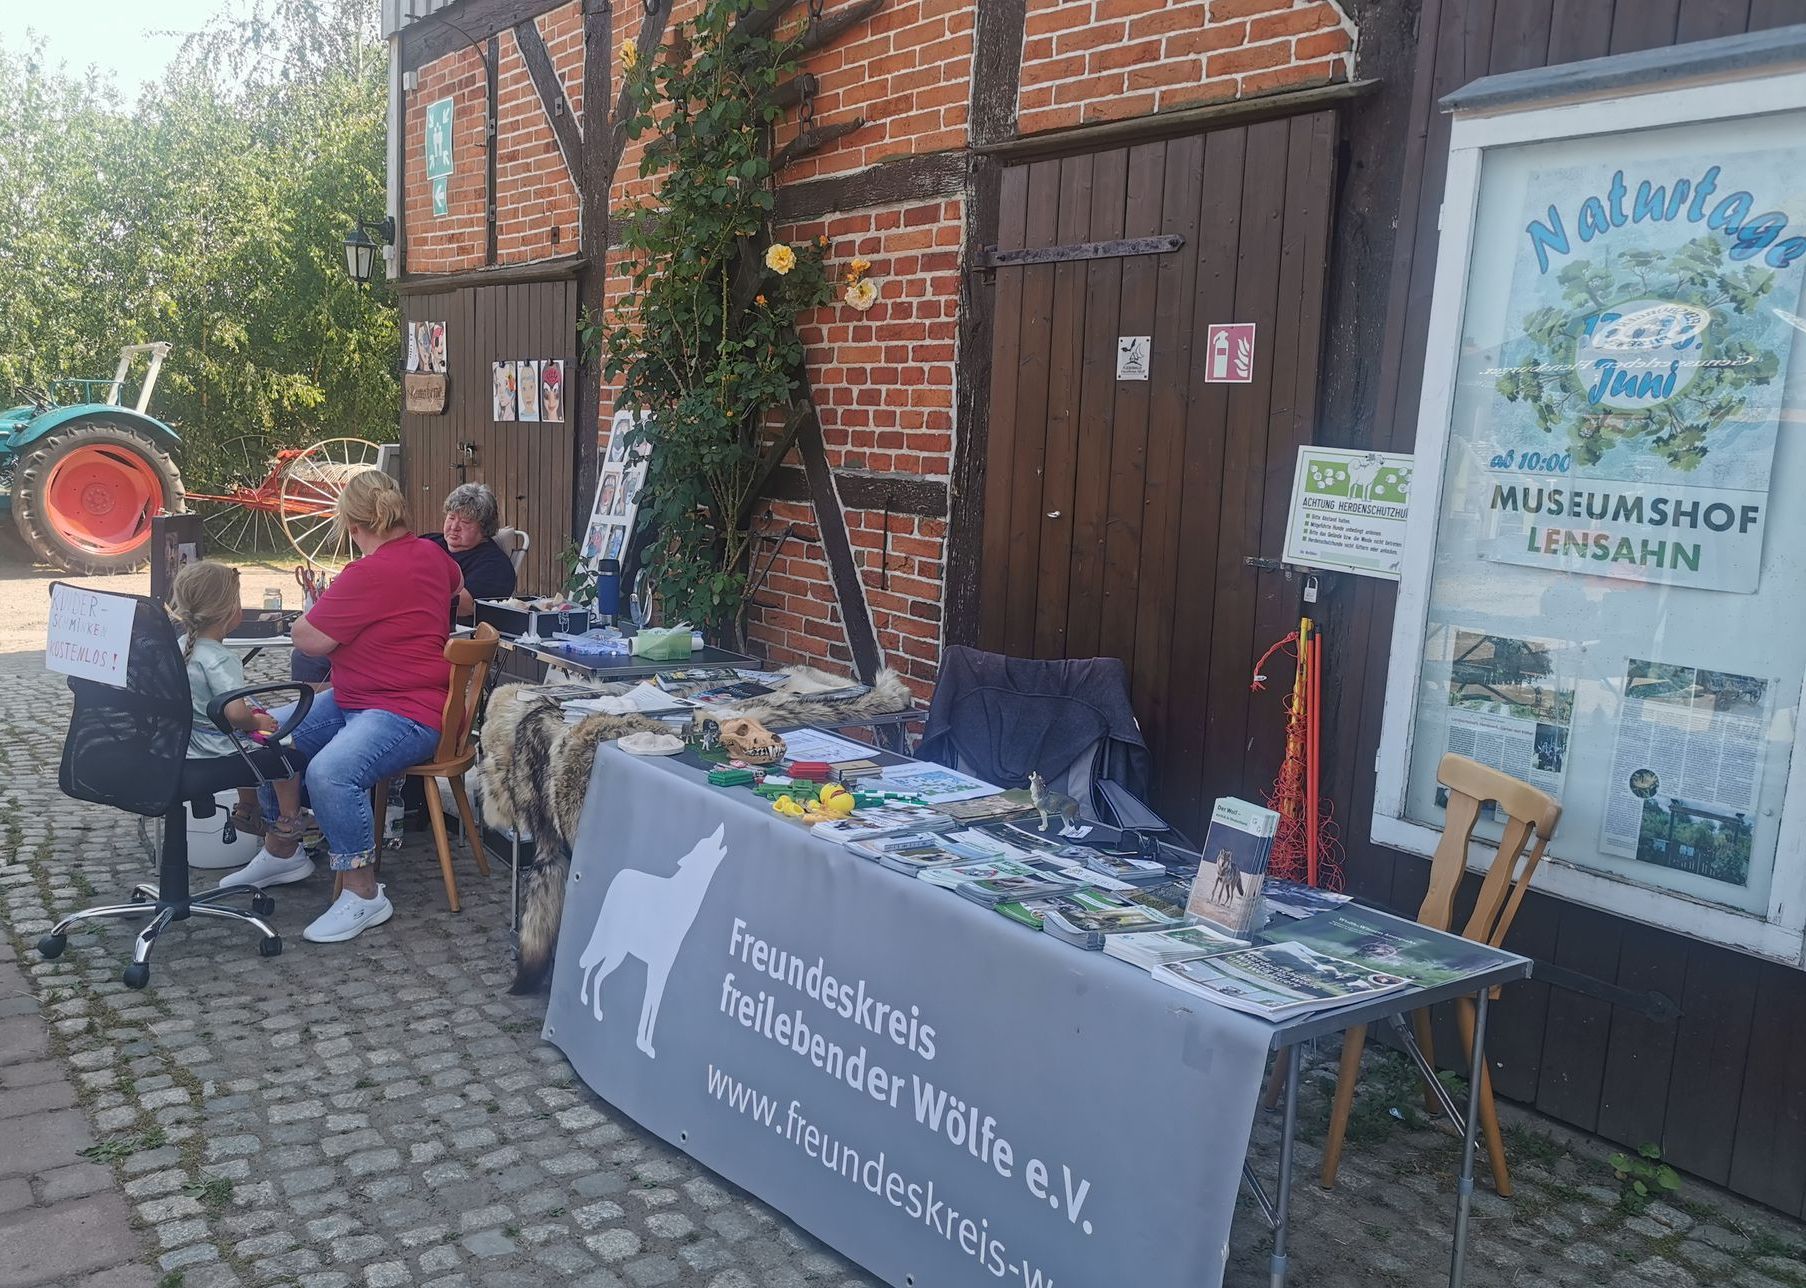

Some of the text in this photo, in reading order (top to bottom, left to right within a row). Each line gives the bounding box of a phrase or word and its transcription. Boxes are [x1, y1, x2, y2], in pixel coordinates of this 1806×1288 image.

[1526, 165, 1806, 275] Naturtage
[1588, 358, 1679, 406] Juni
[1490, 449, 1571, 473] ab 10:00
[1303, 497, 1335, 509] ACHTUNG
[1491, 484, 1760, 535] MUSEUMSHOF
[1527, 525, 1702, 573] LENSAHN
[729, 917, 936, 1061] Freundeskreis
[720, 972, 1093, 1235] freilebender Wölfe e.V.
